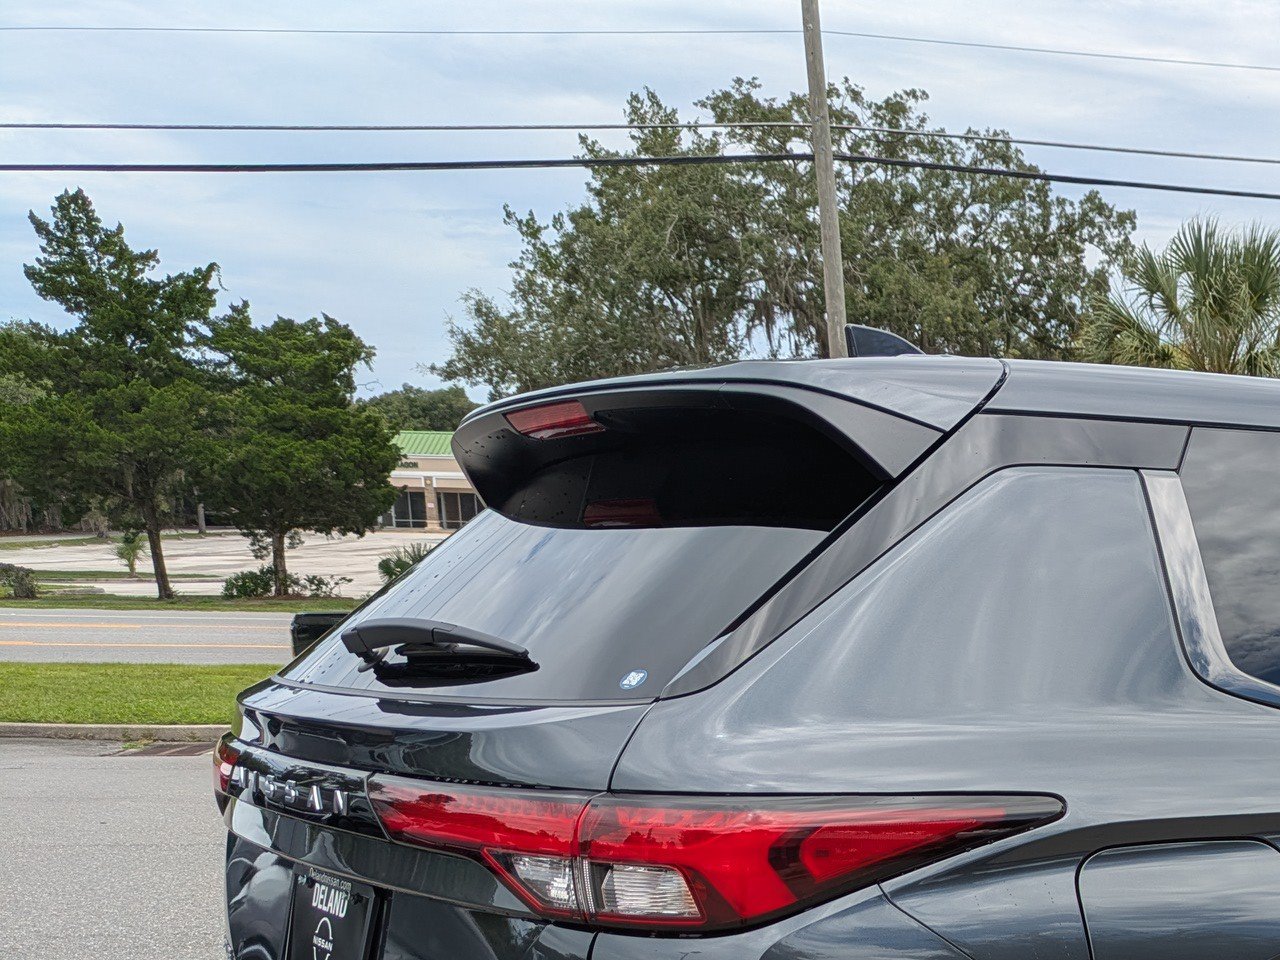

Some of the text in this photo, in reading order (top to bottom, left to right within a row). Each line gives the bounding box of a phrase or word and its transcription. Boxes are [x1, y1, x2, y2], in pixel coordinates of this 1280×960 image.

[240, 766, 349, 817] NISSAN
[312, 882, 350, 918] DELAND
[312, 934, 333, 952] NISSAN
